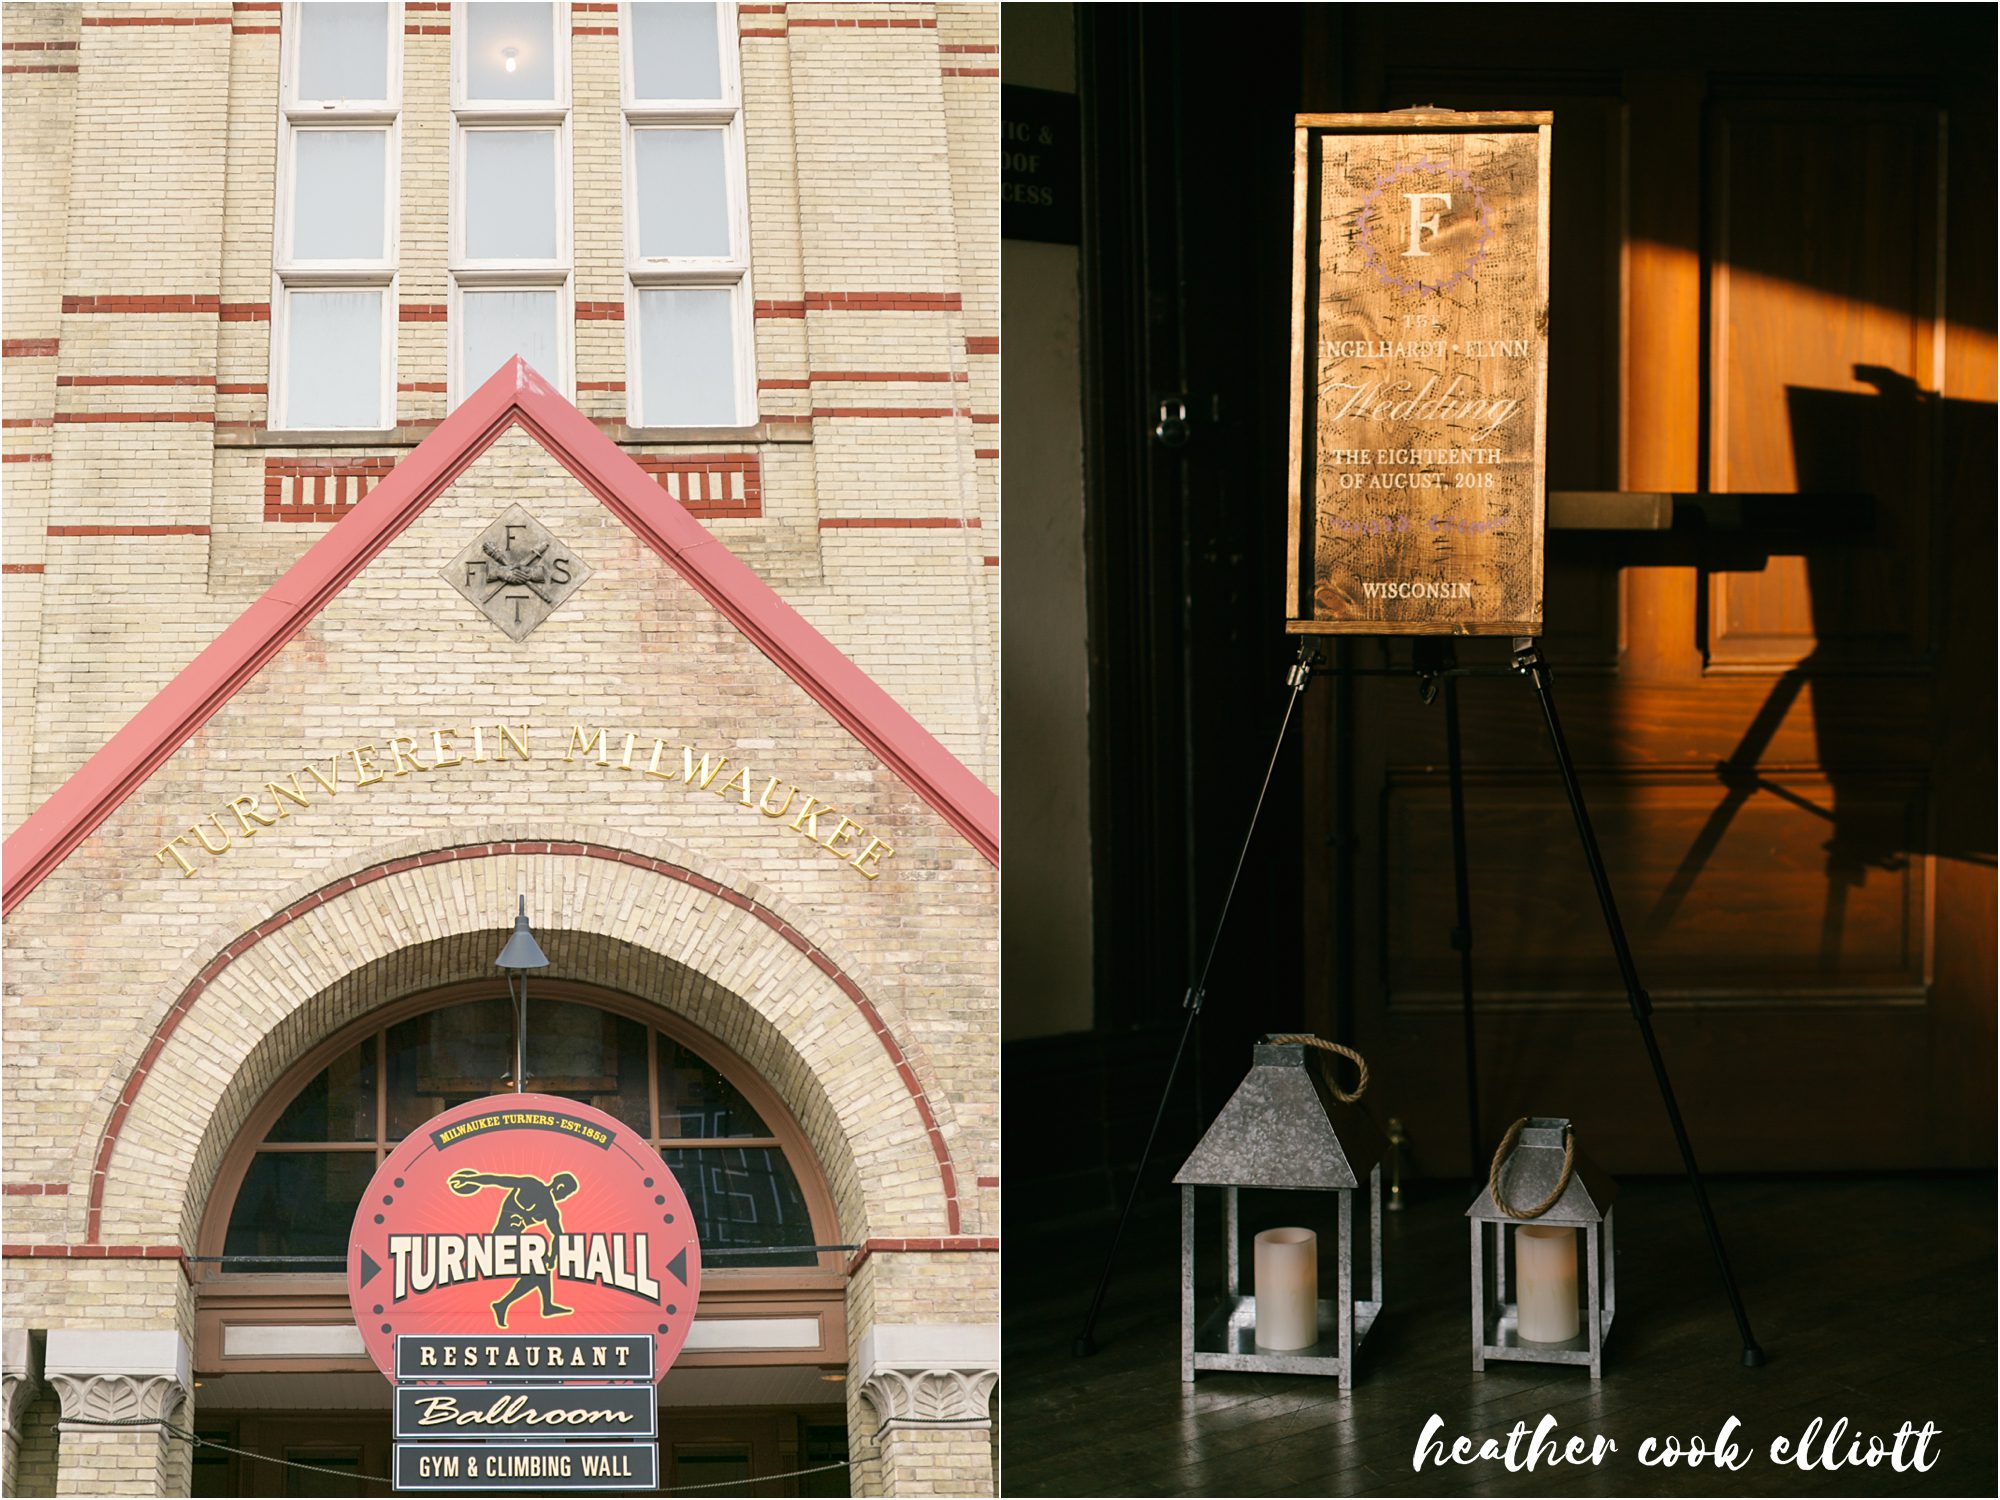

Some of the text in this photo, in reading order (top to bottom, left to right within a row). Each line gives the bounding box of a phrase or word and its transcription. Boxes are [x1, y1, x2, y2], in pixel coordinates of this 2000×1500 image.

[1038, 125, 1054, 145] &
[1401, 193, 1451, 257] F
[1466, 340, 1528, 357] FLYNN
[1322, 375, 1525, 441] Wedding
[1333, 449, 1501, 465] THE EIGHTEENTH
[1340, 473, 1494, 491] OF AUGUST, 2018
[505, 525, 527, 551] F
[465, 558, 572, 587] F S
[1363, 582, 1472, 599] WISCONSIN
[505, 595, 530, 625] T
[154, 723, 897, 882] TURNVEREIN MILWAUKEE
[439, 1116, 500, 1144] MILWAUKEE
[502, 1114, 554, 1126] TURNERS
[389, 1233, 660, 1304] TURNER HALL
[420, 1346, 631, 1367] RESTAURANT
[414, 1394, 634, 1427] Ballroom
[419, 1455, 632, 1478] GYM & CLIMBING WALL
